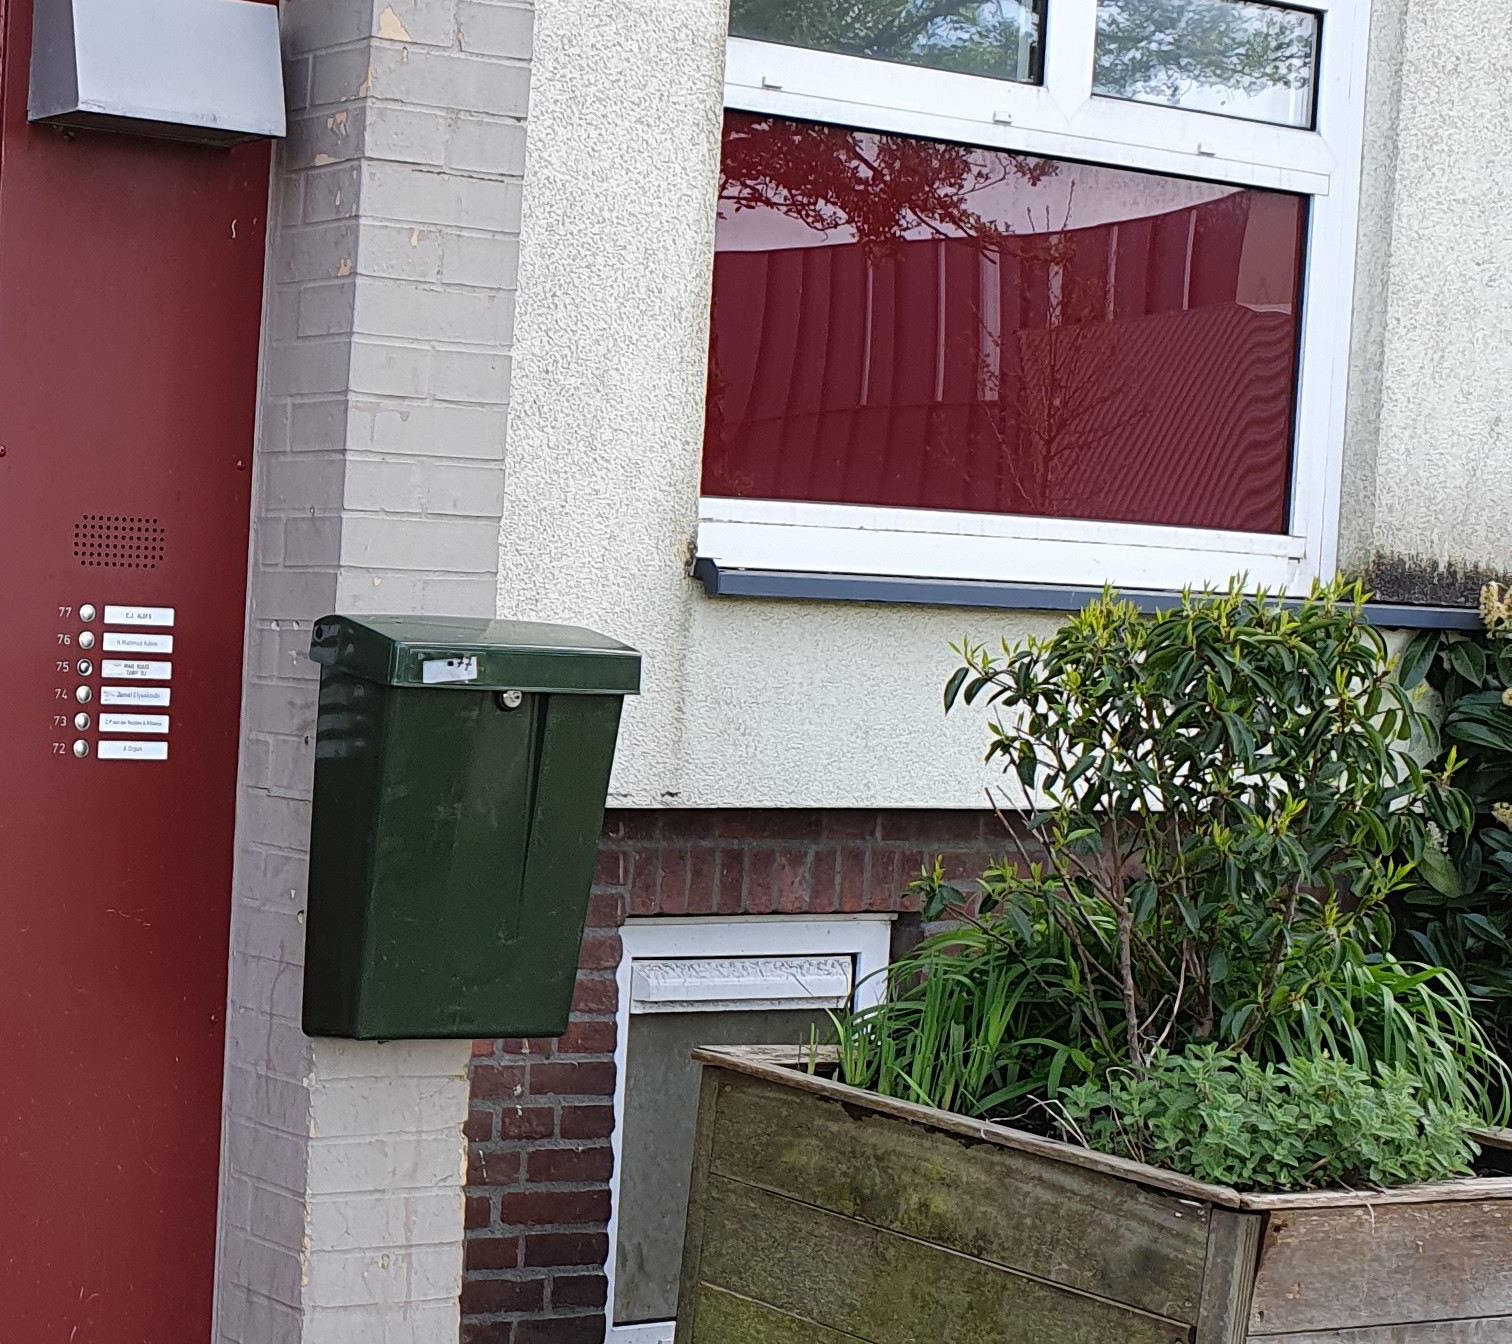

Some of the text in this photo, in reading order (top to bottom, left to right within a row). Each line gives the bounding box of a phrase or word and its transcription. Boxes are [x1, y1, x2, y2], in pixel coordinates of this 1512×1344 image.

[58, 606, 72, 618] 77
[57, 634, 71, 645] 76
[56, 661, 69, 673] 75
[54, 688, 68, 700] 74
[53, 715, 67, 727] 73
[52, 742, 66, 754] 72
